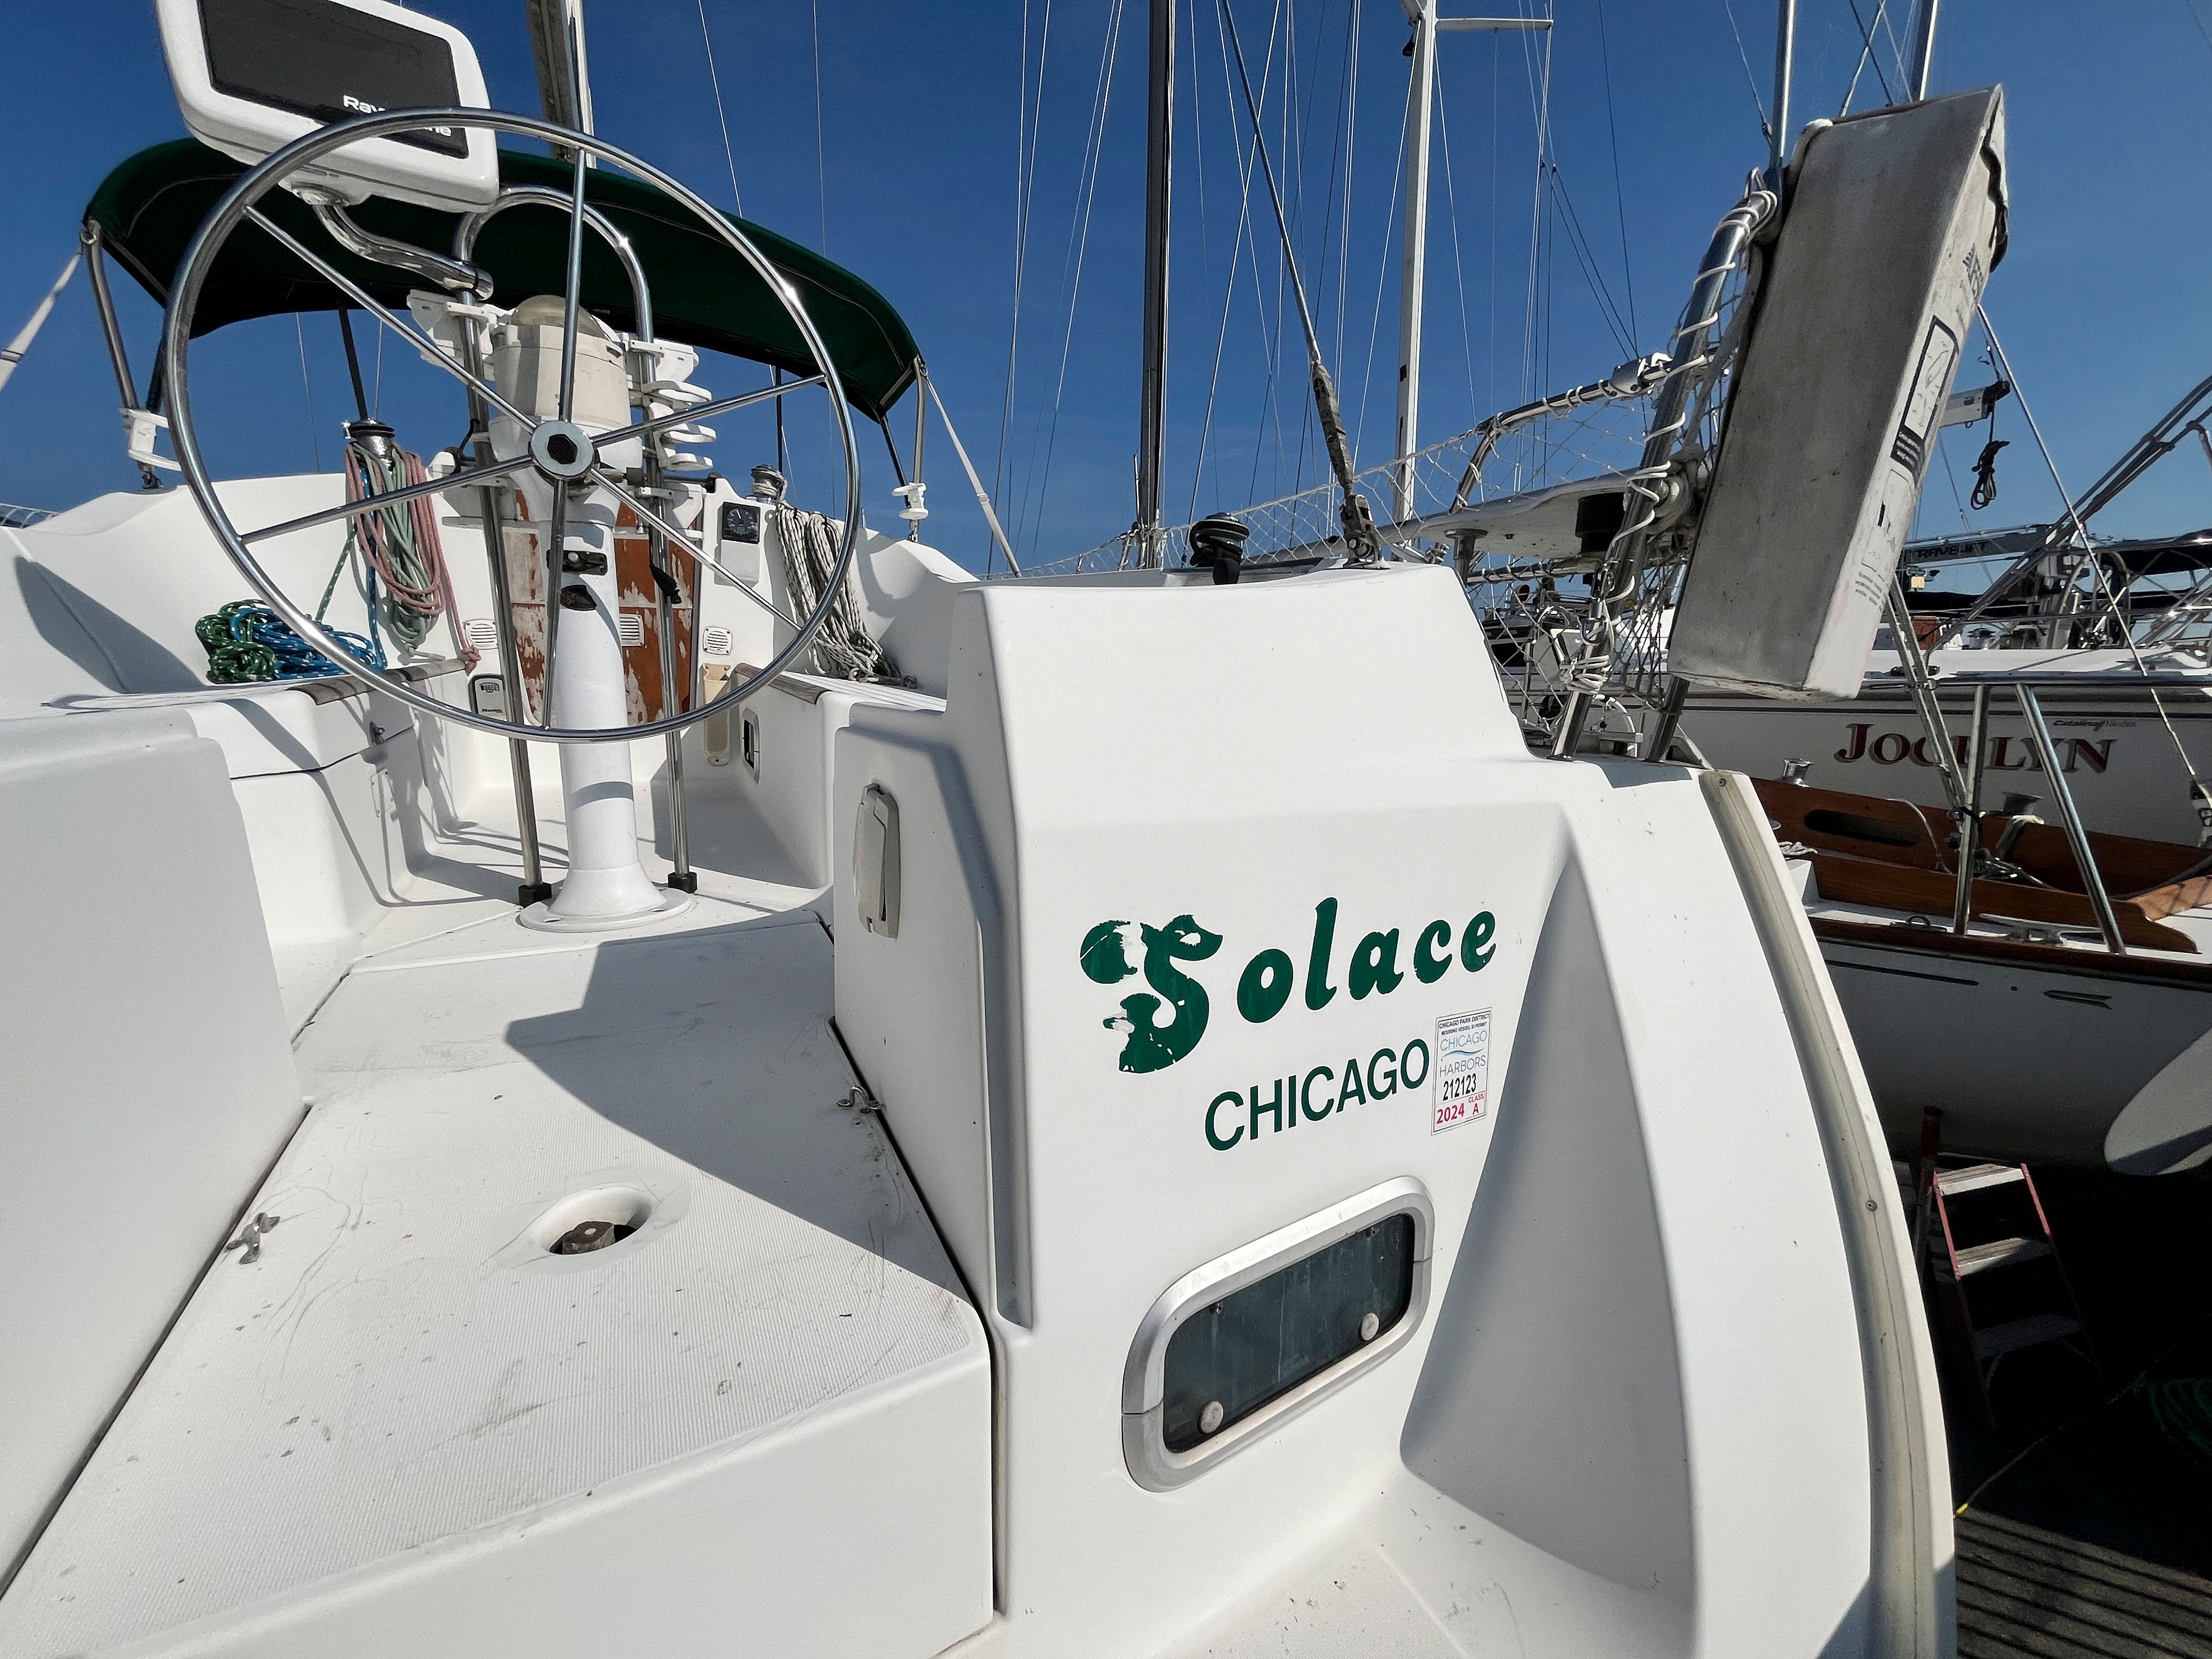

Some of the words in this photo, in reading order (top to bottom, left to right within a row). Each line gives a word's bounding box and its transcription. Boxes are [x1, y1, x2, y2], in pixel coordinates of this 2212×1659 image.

[1080, 897, 1496, 1074] Solace
[1439, 1020, 1459, 1029] CHICAGO
[1471, 1013, 1490, 1022] DISTRICT
[1440, 1030, 1487, 1051] CHICAGO
[1440, 1054, 1486, 1077] HARBORS
[1205, 1039, 1429, 1151] CHICAGO
[1443, 1073, 1476, 1102] 212123
[1468, 1093, 1484, 1103] CLASS
[1436, 1103, 1465, 1124] 2024
[1472, 1103, 1479, 1115] A
